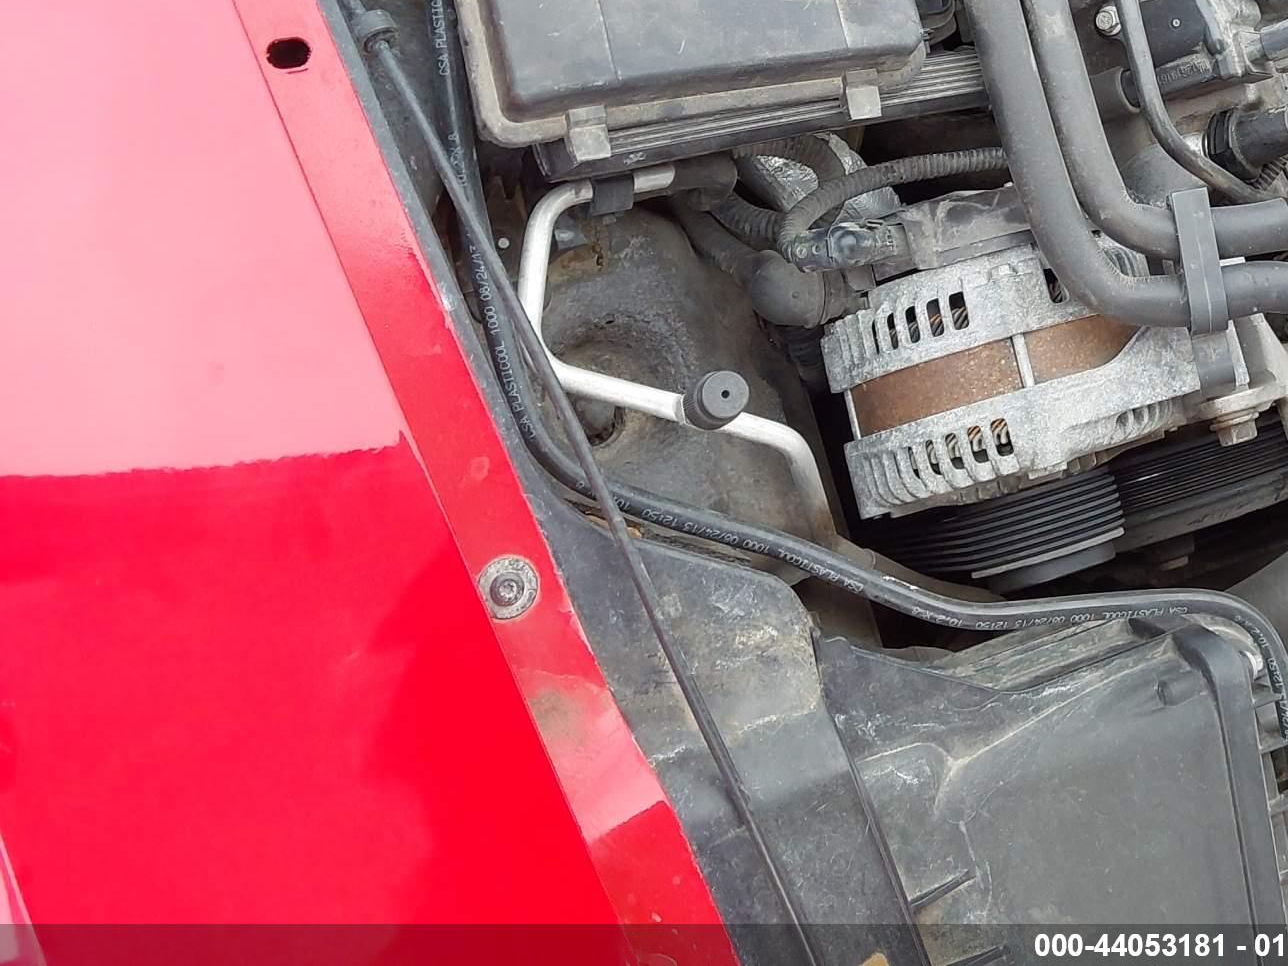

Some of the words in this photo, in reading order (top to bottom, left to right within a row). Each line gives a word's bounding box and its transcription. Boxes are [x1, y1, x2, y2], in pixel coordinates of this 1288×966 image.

[436, 53, 450, 76] CSA
[484, 306, 501, 336] 1000
[495, 340, 525, 411] PLASTICOOL
[641, 507, 679, 528] 12:50
[683, 521, 740, 547] 08/24/13
[742, 538, 771, 555] 1000
[777, 548, 842, 582] PLASTICOOL
[842, 576, 865, 593] CSA
[1069, 613, 1095, 624] 1000
[1102, 607, 1165, 620] PLASTICOOL
[1169, 606, 1188, 616] CSA
[975, 620, 1009, 631] 12:50
[1267, 657, 1283, 688] 12:50
